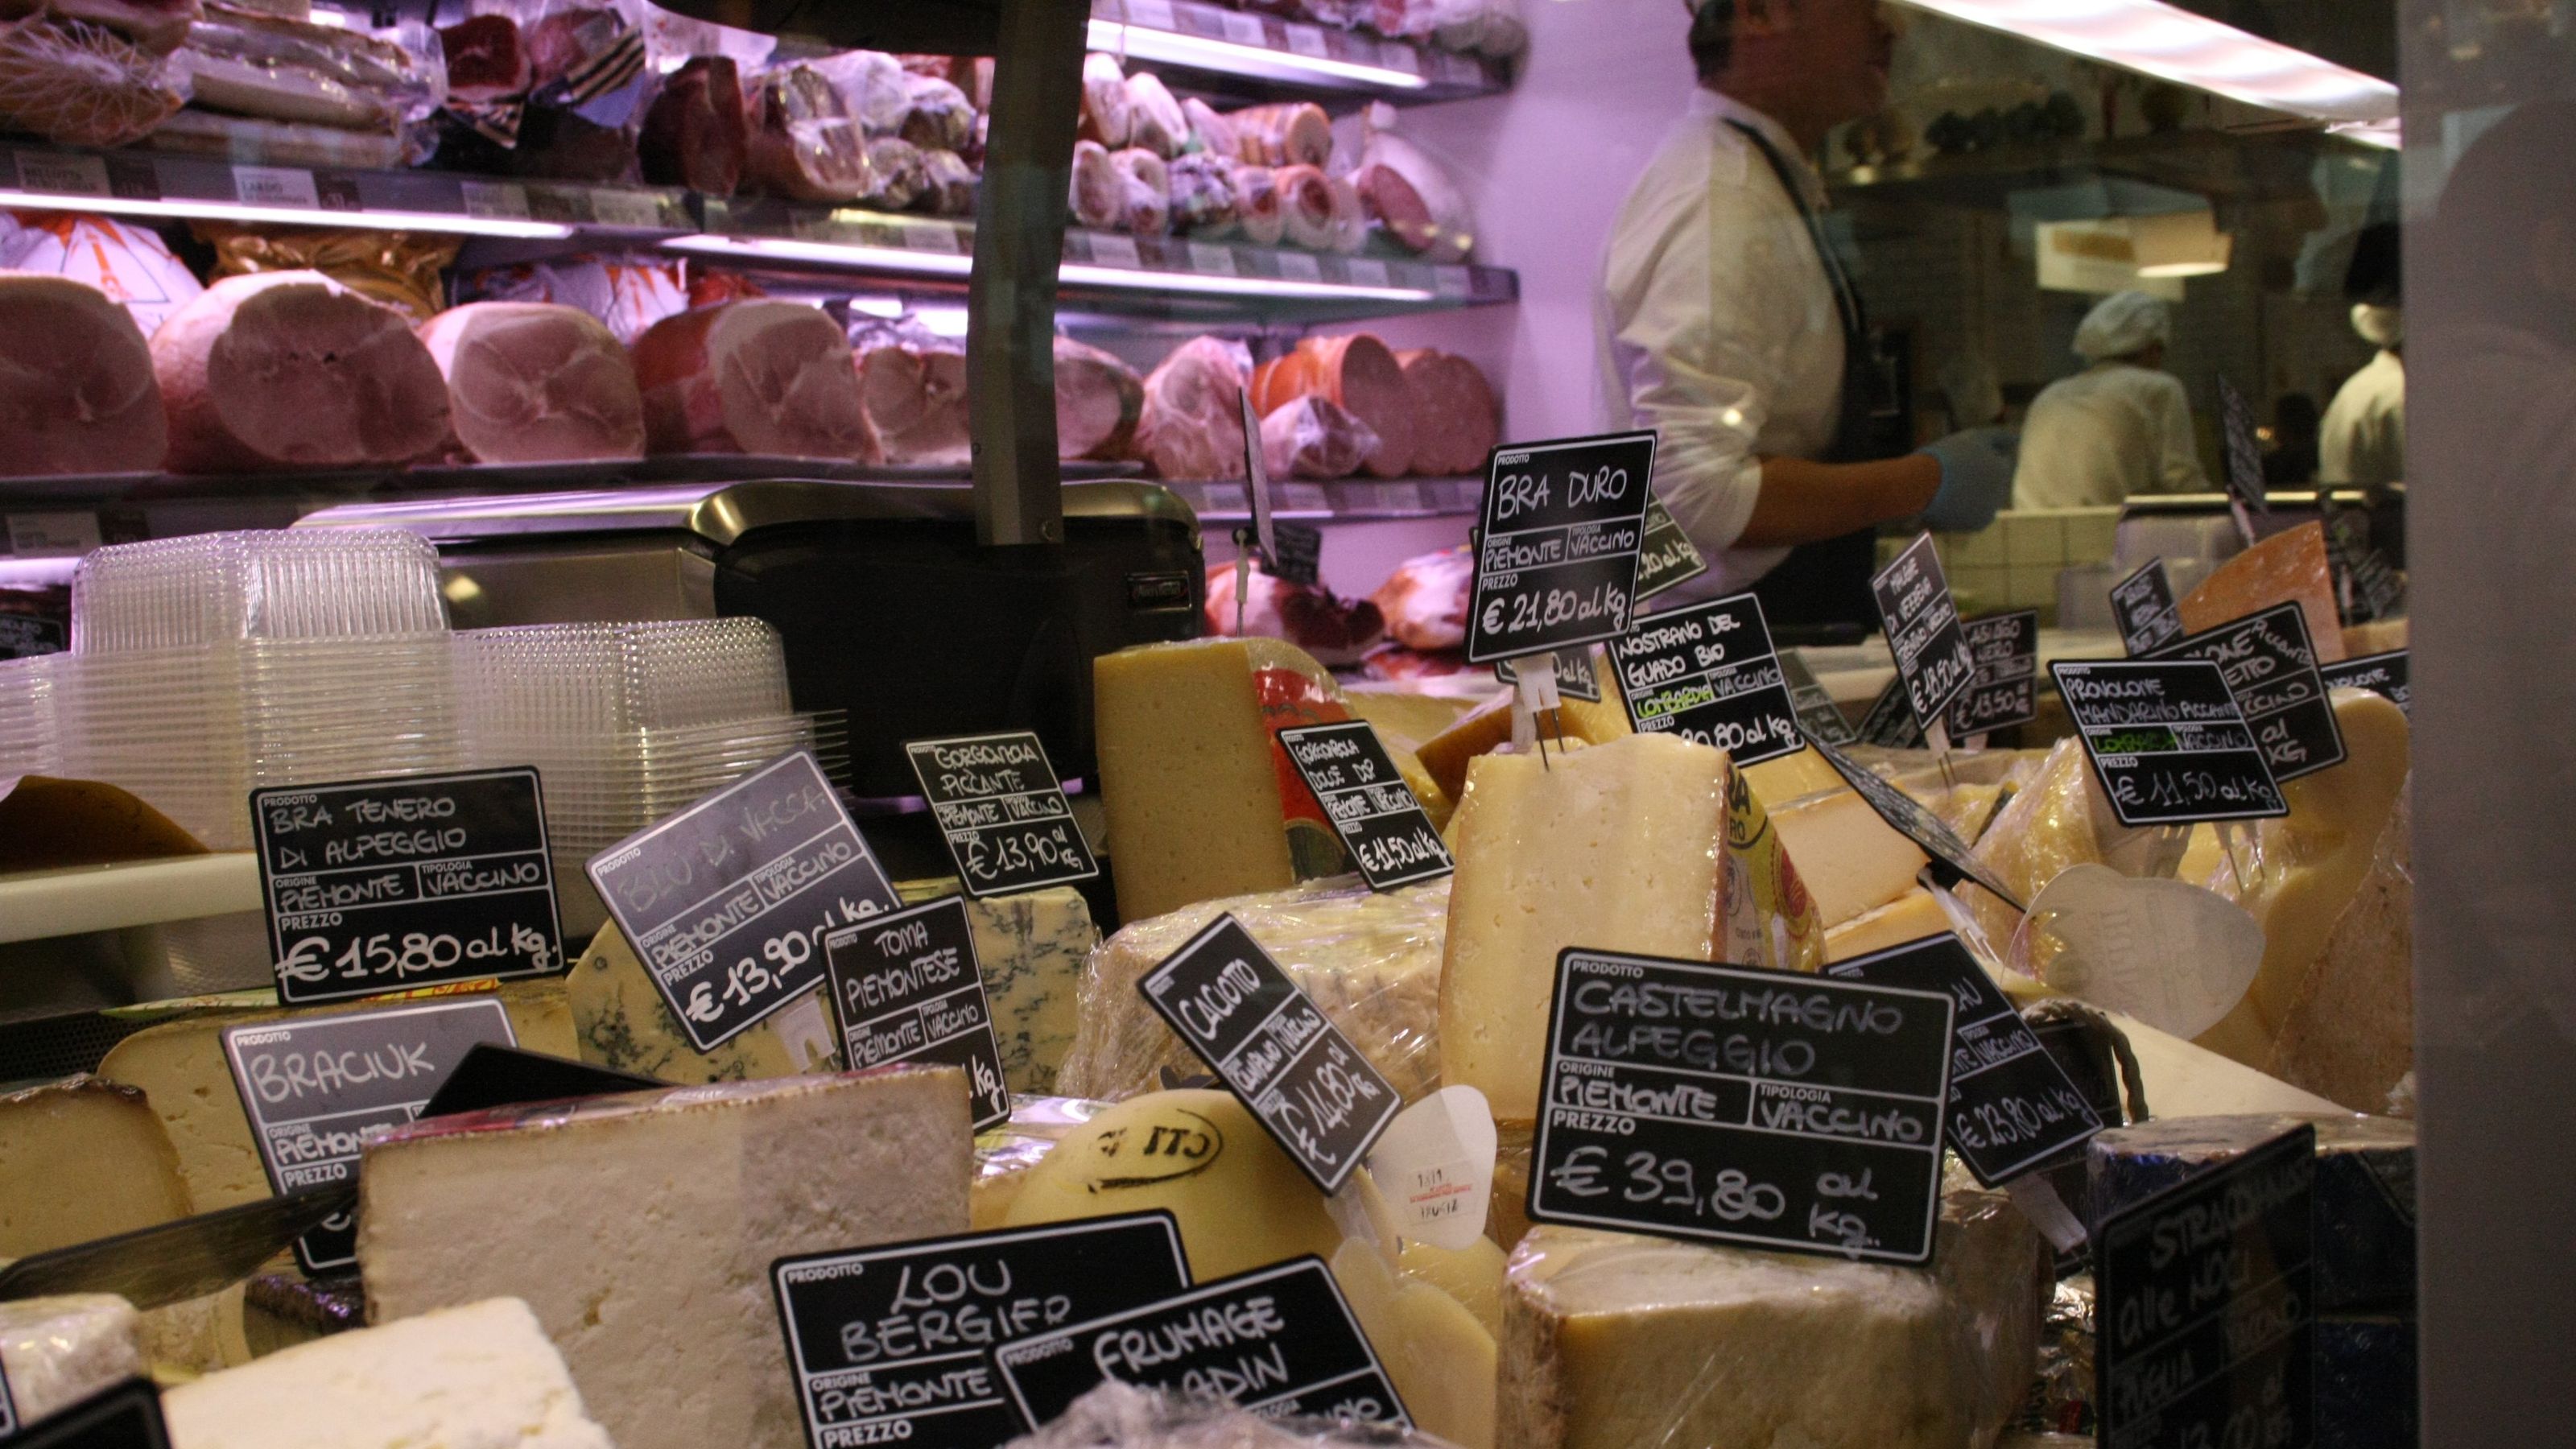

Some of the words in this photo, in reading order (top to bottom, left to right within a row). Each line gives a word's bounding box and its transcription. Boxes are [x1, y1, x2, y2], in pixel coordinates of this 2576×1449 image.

[1498, 454, 1530, 465] PRODOTTO
[1498, 473, 1550, 520] BRA
[1568, 465, 1627, 507] DURO
[1571, 528, 1634, 555] VACCINO
[1572, 525, 1601, 536] TIPOLOGIA
[1485, 539, 1562, 572] PIEMONTE
[1481, 576, 1518, 591] PREZZO
[1619, 621, 1702, 658] NOSTRANO
[1707, 613, 1740, 635] DEL
[1628, 656, 1686, 688] GUADO
[1694, 643, 1724, 668] BIO
[1714, 667, 1780, 696] VACCINO
[2066, 678, 2165, 701] PROVOLONE
[940, 768, 1024, 796] PICCANTE
[264, 795, 317, 807] PRODOTTO
[270, 807, 332, 835] BRA
[345, 797, 455, 824] TENERO
[280, 847, 307, 869] DI
[325, 828, 466, 865] ALPEGGIO
[597, 848, 641, 876] PRODOTTO
[276, 876, 317, 886] ORIGINE
[422, 861, 472, 873] TIPOLOGIA
[427, 863, 539, 895] VACCINO
[753, 857, 795, 883] TIPOLOGIA
[762, 841, 852, 901] VACCINO
[280, 874, 403, 912] PIEMONTE
[281, 912, 342, 931] PREZZO
[642, 924, 677, 948] ORIGINE
[651, 890, 759, 968] PIEMONTE
[874, 920, 928, 957] TOMA
[663, 949, 714, 987] PREZZO
[846, 947, 960, 1013] PIEMONTESE
[1572, 961, 1644, 978] PRODOTTO
[1179, 958, 1261, 1040] CACIOTTO
[1574, 980, 1902, 1034] CASTELMAGNO
[927, 1004, 979, 1039] VACCINO
[237, 1031, 291, 1046] PRODOTTO
[854, 1020, 921, 1067] PIEMONTE
[1571, 1020, 1815, 1075] ALPEGGIO
[250, 1042, 434, 1103] BRACIUK
[1560, 1060, 1615, 1078] ORIGINE
[1560, 1075, 1718, 1120] PIEMONTE
[1760, 1084, 1831, 1104] TIPOLOGIA
[269, 1123, 311, 1137] ORIGINE
[1553, 1109, 1636, 1136] PREZZO
[1761, 1100, 1922, 1141] VACCINO
[285, 1163, 346, 1187] PREZZO
[1816, 1166, 1878, 1200] al
[787, 1263, 863, 1284] PRODOTTO
[891, 1259, 1011, 1315] LOU
[1009, 1338, 1074, 1366] PRODOTTO
[1094, 1296, 1285, 1382] FRUMAGE
[811, 1372, 871, 1390] ORIGINE
[819, 1368, 993, 1422] PIEMONTE
[824, 1419, 912, 1449] PREZZO
